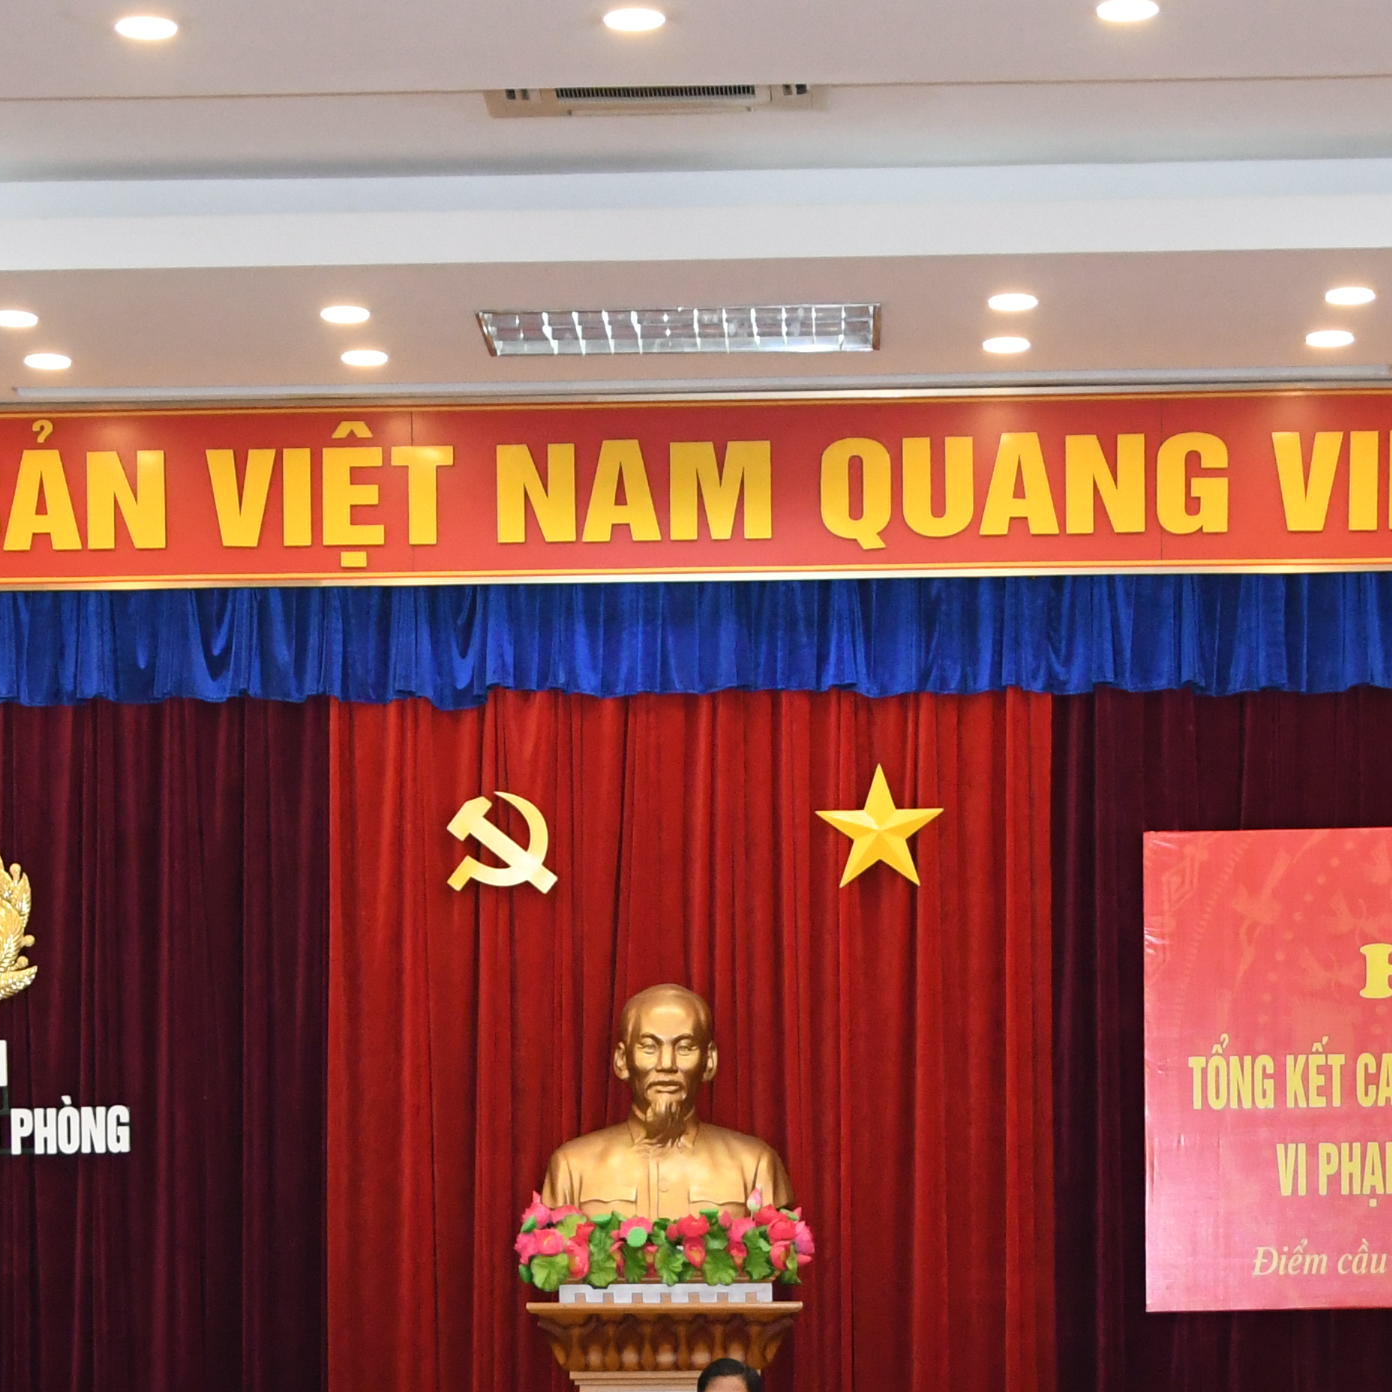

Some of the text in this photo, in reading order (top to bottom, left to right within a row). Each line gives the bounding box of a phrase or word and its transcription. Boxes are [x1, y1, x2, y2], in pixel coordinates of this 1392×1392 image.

[206, 420, 453, 567] VIỆT
[497, 440, 772, 543] NAM
[821, 423, 1228, 550] QUANG
[1188, 1032, 1275, 1110] TỔNG
[1285, 1035, 1346, 1109] KẾT
[10, 1095, 131, 1156] PHÒNG
[1276, 1142, 1308, 1198] VI
[1252, 1238, 1329, 1277] Điểm
[1337, 1243, 1387, 1276] cầu
